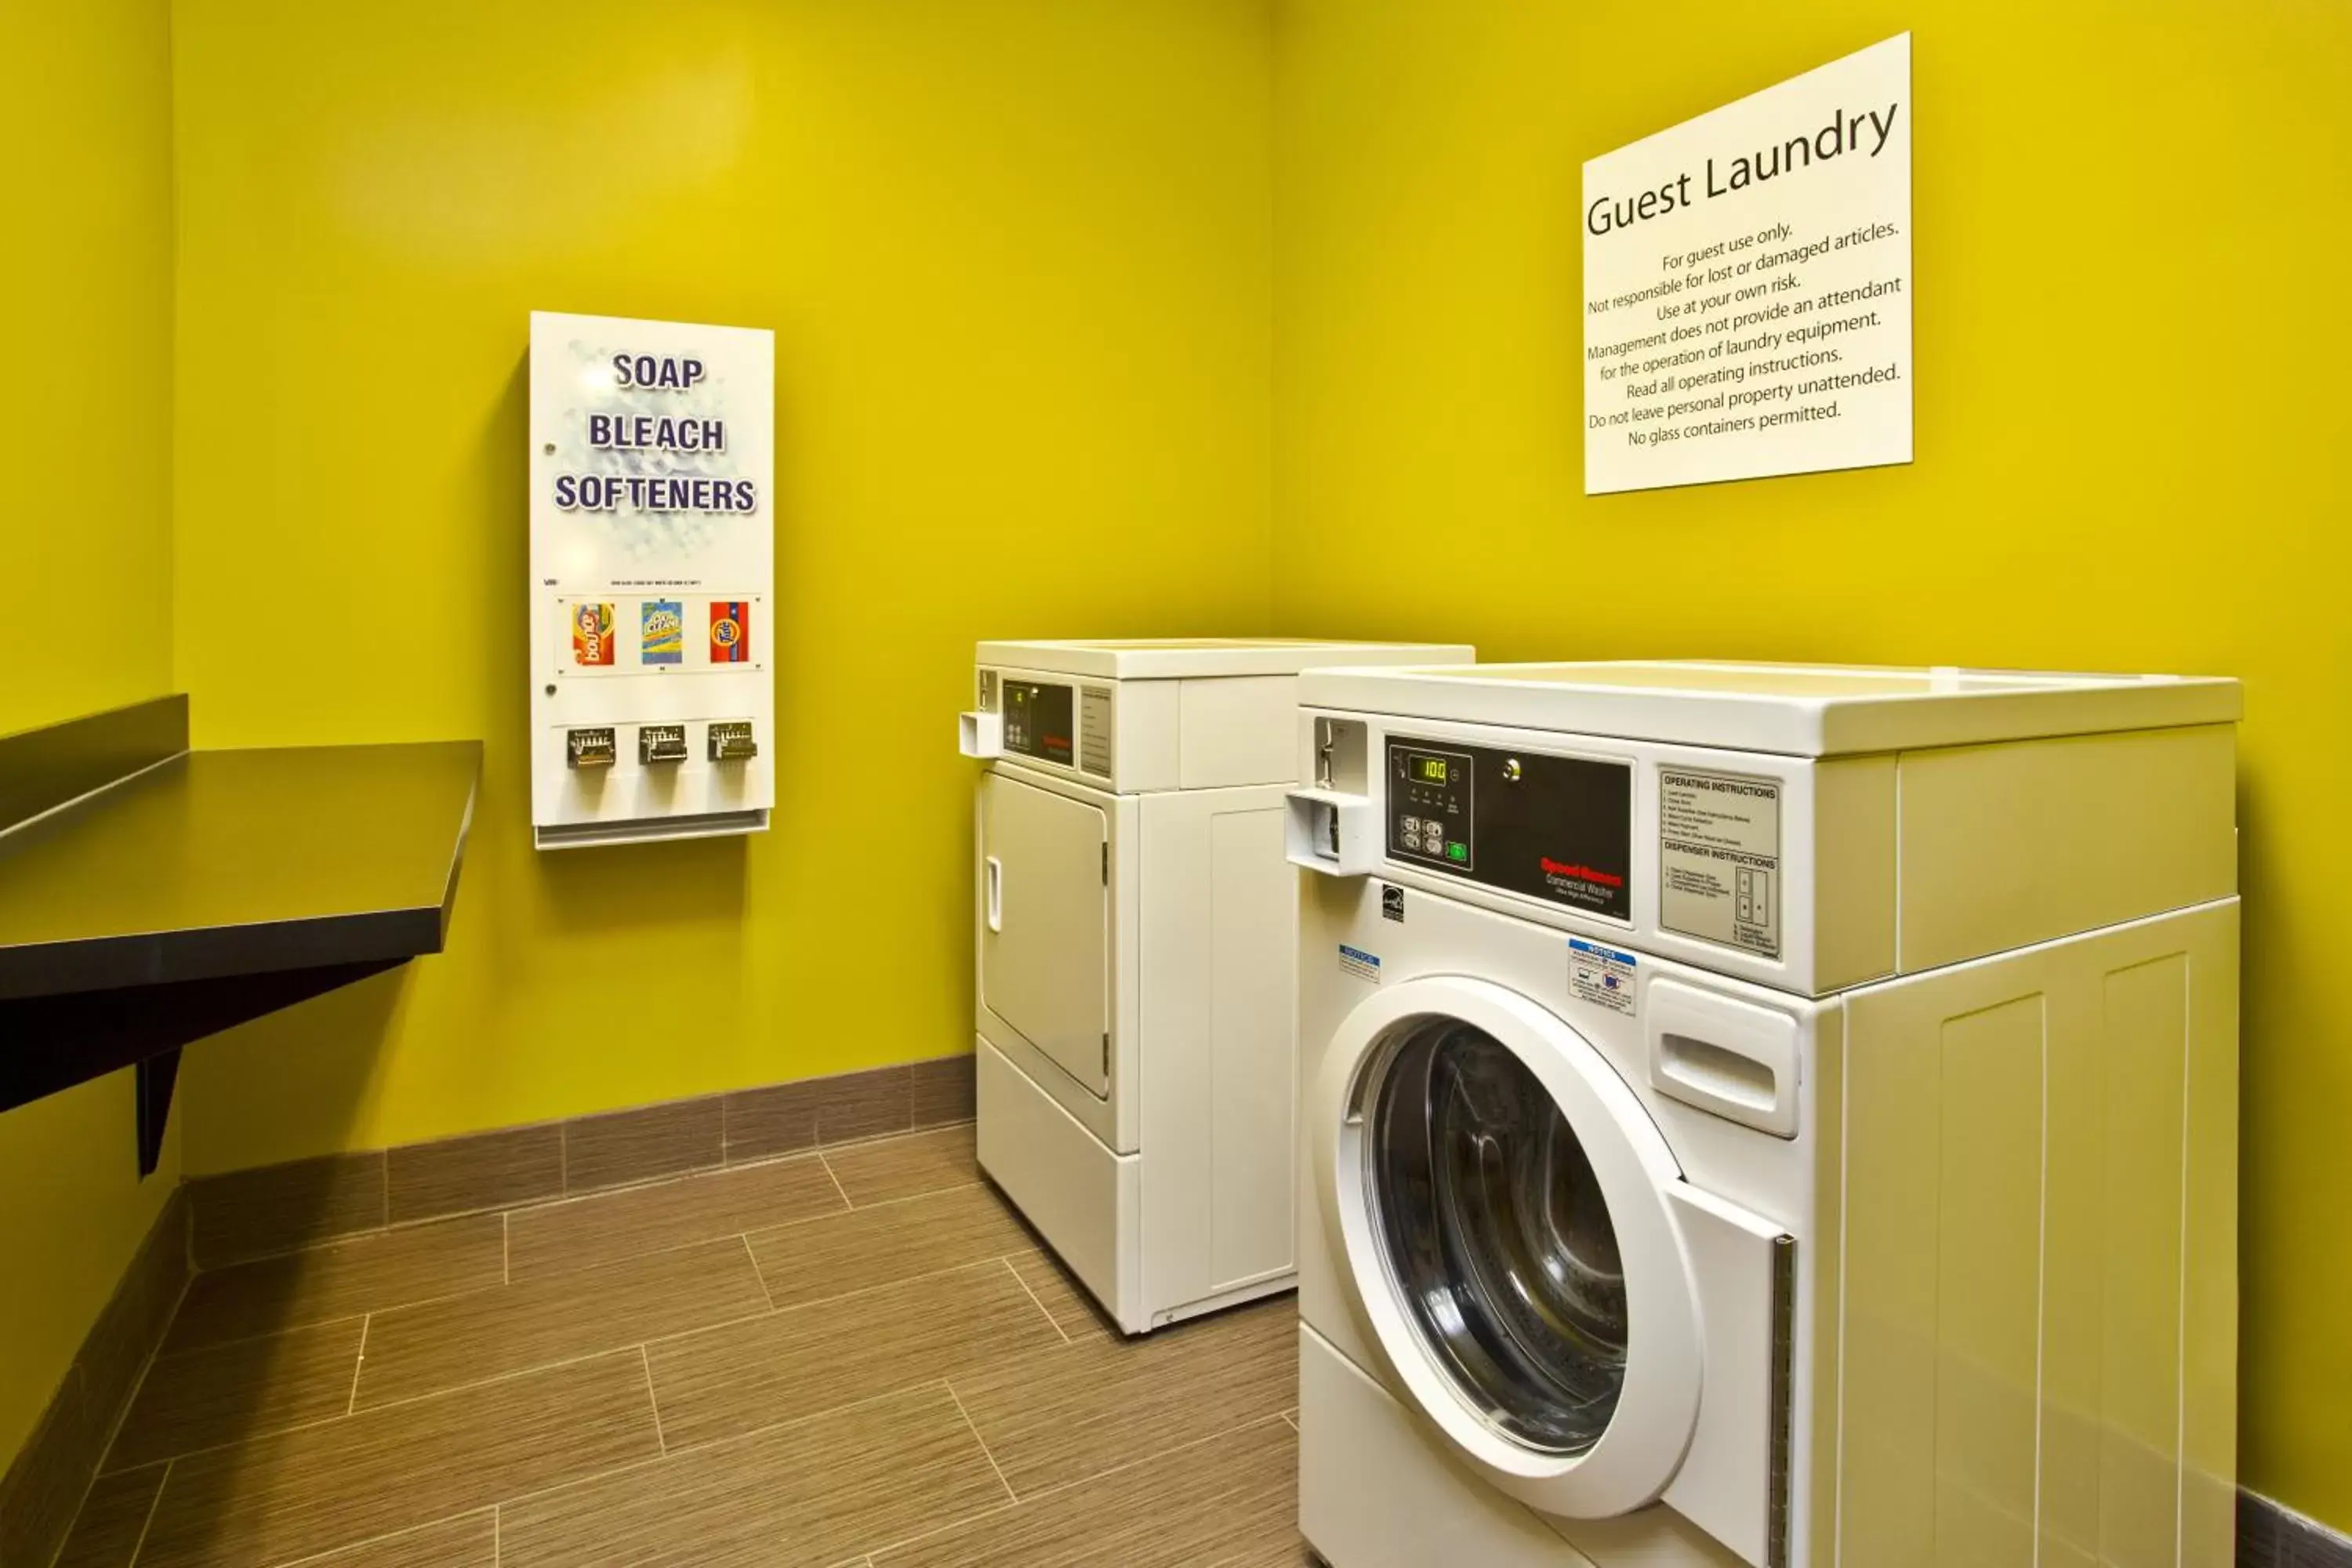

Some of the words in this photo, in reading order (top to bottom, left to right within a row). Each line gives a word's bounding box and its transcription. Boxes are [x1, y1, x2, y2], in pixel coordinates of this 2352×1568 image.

[1588, 172, 1691, 236] Guest
[1707, 103, 1898, 198] Laundry
[1588, 299, 1609, 314] Not
[1613, 278, 1682, 308] responsible
[1686, 273, 1704, 289] for
[1708, 265, 1733, 283] lost
[1737, 261, 1752, 275] or
[1755, 235, 1829, 270] damaged
[1834, 223, 1900, 250] articles.
[1663, 255, 1684, 271] For
[1686, 242, 1725, 268] guest
[1729, 235, 1754, 252] use
[1757, 222, 1792, 244] only.
[1588, 332, 1667, 360] Management
[1670, 325, 1702, 343] does
[1705, 317, 1730, 334] not
[1733, 302, 1790, 332] provide
[1793, 299, 1813, 314] an
[1817, 278, 1902, 310] attendant
[1657, 305, 1680, 321] Use
[1683, 300, 1697, 314] at
[1700, 292, 1731, 314] your
[1735, 284, 1767, 302] own
[1771, 272, 1801, 293] risk.
[1600, 366, 1617, 380] for
[1620, 361, 1639, 376] the
[1642, 349, 1705, 374] operation
[1708, 340, 1723, 358] of
[1726, 332, 1782, 355] laundry
[1785, 311, 1881, 344] equipment.
[612, 354, 703, 389] SOAP
[1627, 379, 1657, 399] Read
[1661, 376, 1675, 393] all
[1679, 366, 1744, 391] operating
[1749, 349, 1842, 376] instructions.
[1589, 415, 1606, 429] Do
[1609, 411, 1629, 425] not
[1632, 407, 1664, 421] leave
[1668, 391, 1724, 421] personal
[1729, 384, 1793, 410] property
[1798, 363, 1900, 395] unattended.
[590, 414, 724, 450] BLEACH
[1628, 431, 1646, 445] No
[1649, 427, 1680, 447] glass
[1683, 417, 1755, 438] containers
[1759, 401, 1841, 431] permitted.
[555, 475, 755, 510] SOFTENERS
[717, 620, 735, 643] Tide
[1425, 761, 1446, 779] 100
[1664, 775, 1710, 790] OPERATING
[1711, 782, 1776, 799] INSTRUCTIONS
[1664, 841, 1710, 857] DISPENSER
[1711, 851, 1776, 869] INSTRUCTIONS
